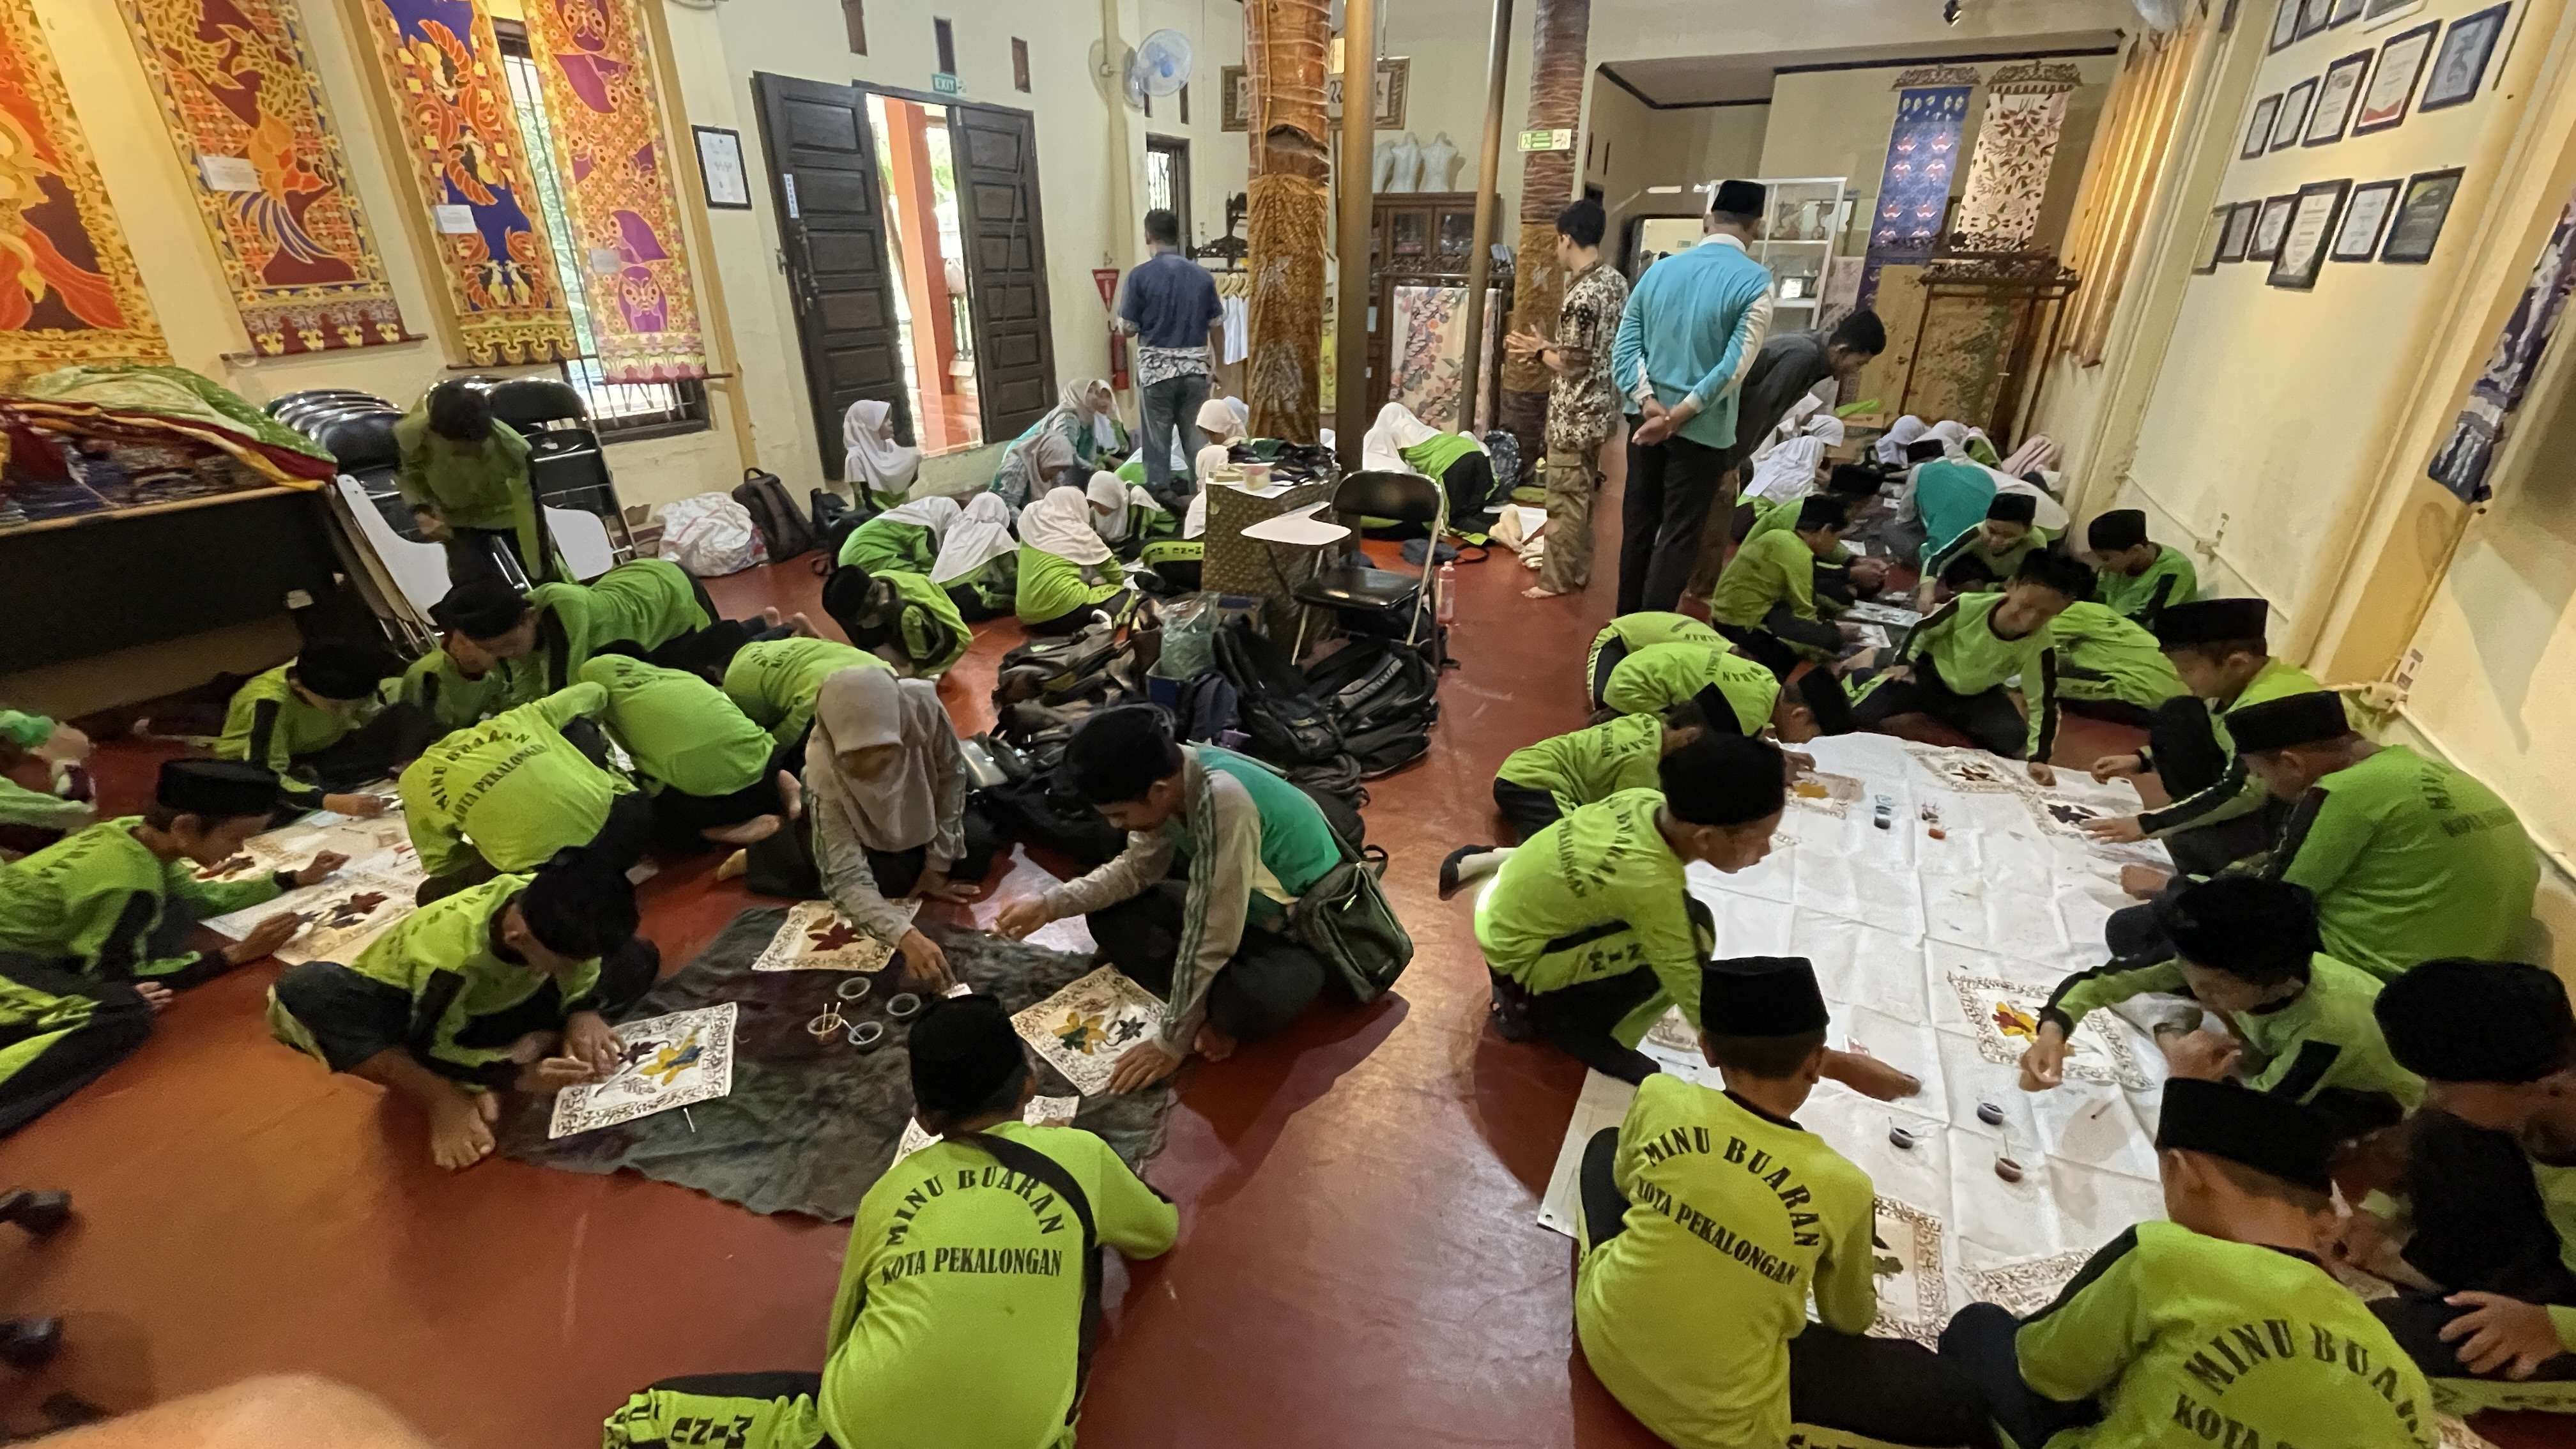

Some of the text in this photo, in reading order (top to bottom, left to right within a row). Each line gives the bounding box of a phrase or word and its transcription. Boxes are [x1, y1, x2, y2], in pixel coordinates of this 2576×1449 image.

[885, 1166, 1064, 1247] MINU BUARAN
[1644, 1126, 1820, 1246] MINU BUARAN
[882, 1247, 1062, 1286] KOTA PEKALONGAN
[1675, 1202, 1800, 1285] PEKALONGAN
[2173, 1392, 2260, 1449] KOTA
[2184, 1319, 2428, 1449] MINU BUAR
